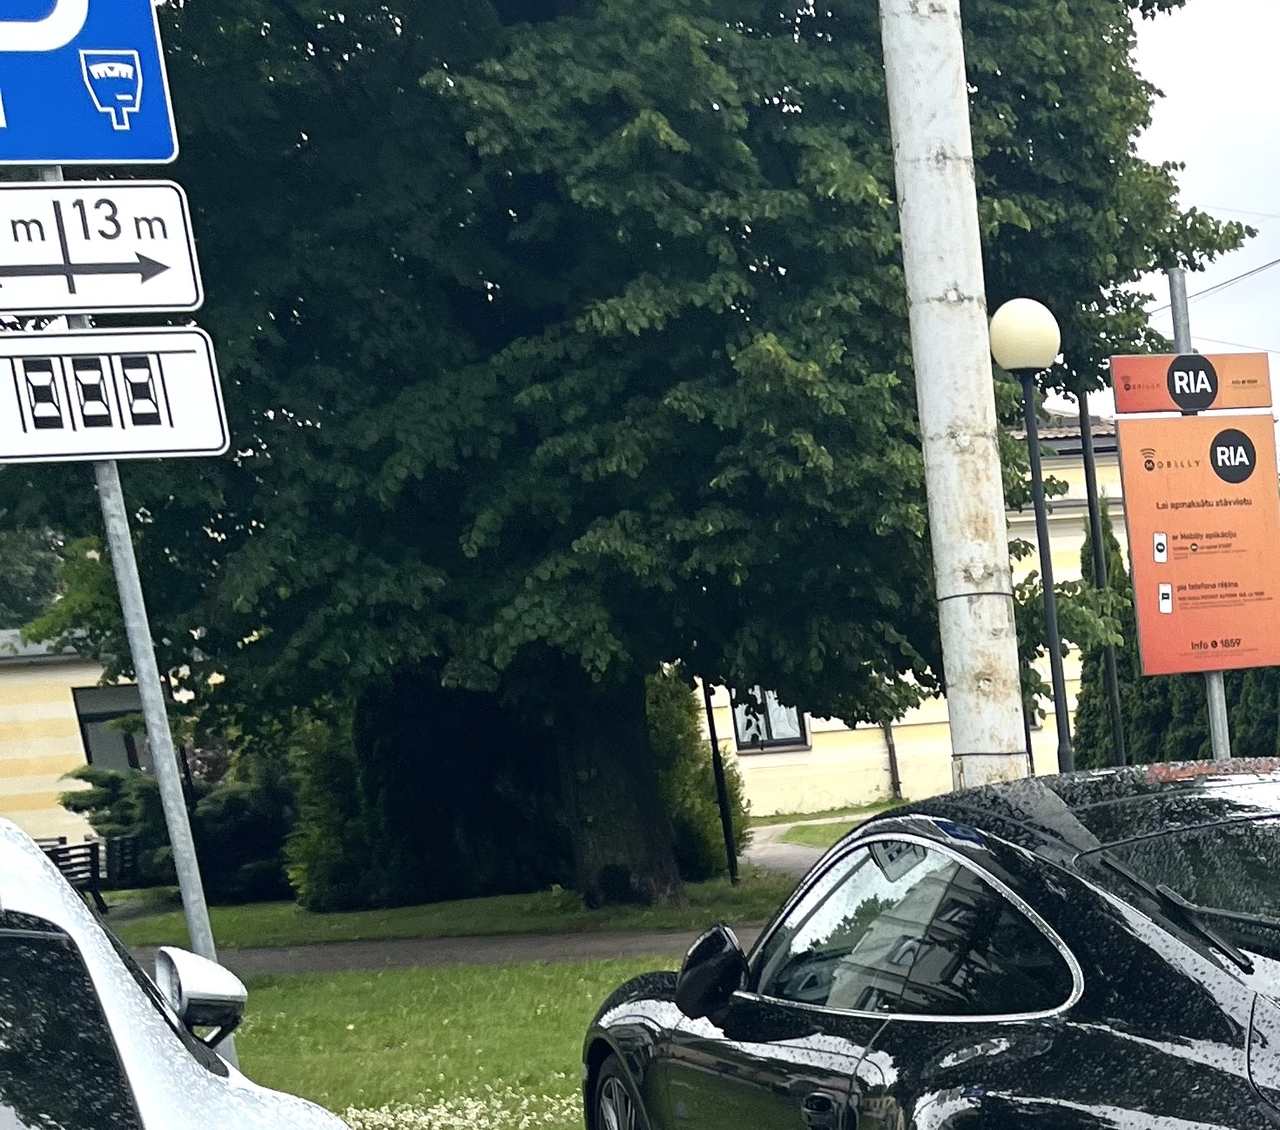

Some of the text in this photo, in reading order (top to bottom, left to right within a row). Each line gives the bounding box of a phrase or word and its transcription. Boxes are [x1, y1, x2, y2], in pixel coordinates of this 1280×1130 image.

[12, 217, 46, 242] m
[72, 198, 169, 241] 13 m
[1173, 370, 1213, 394] RIA
[1216, 446, 1250, 467] RIA
[1156, 500, 1168, 510] Lai
[1191, 638, 1242, 650] Info 1859
